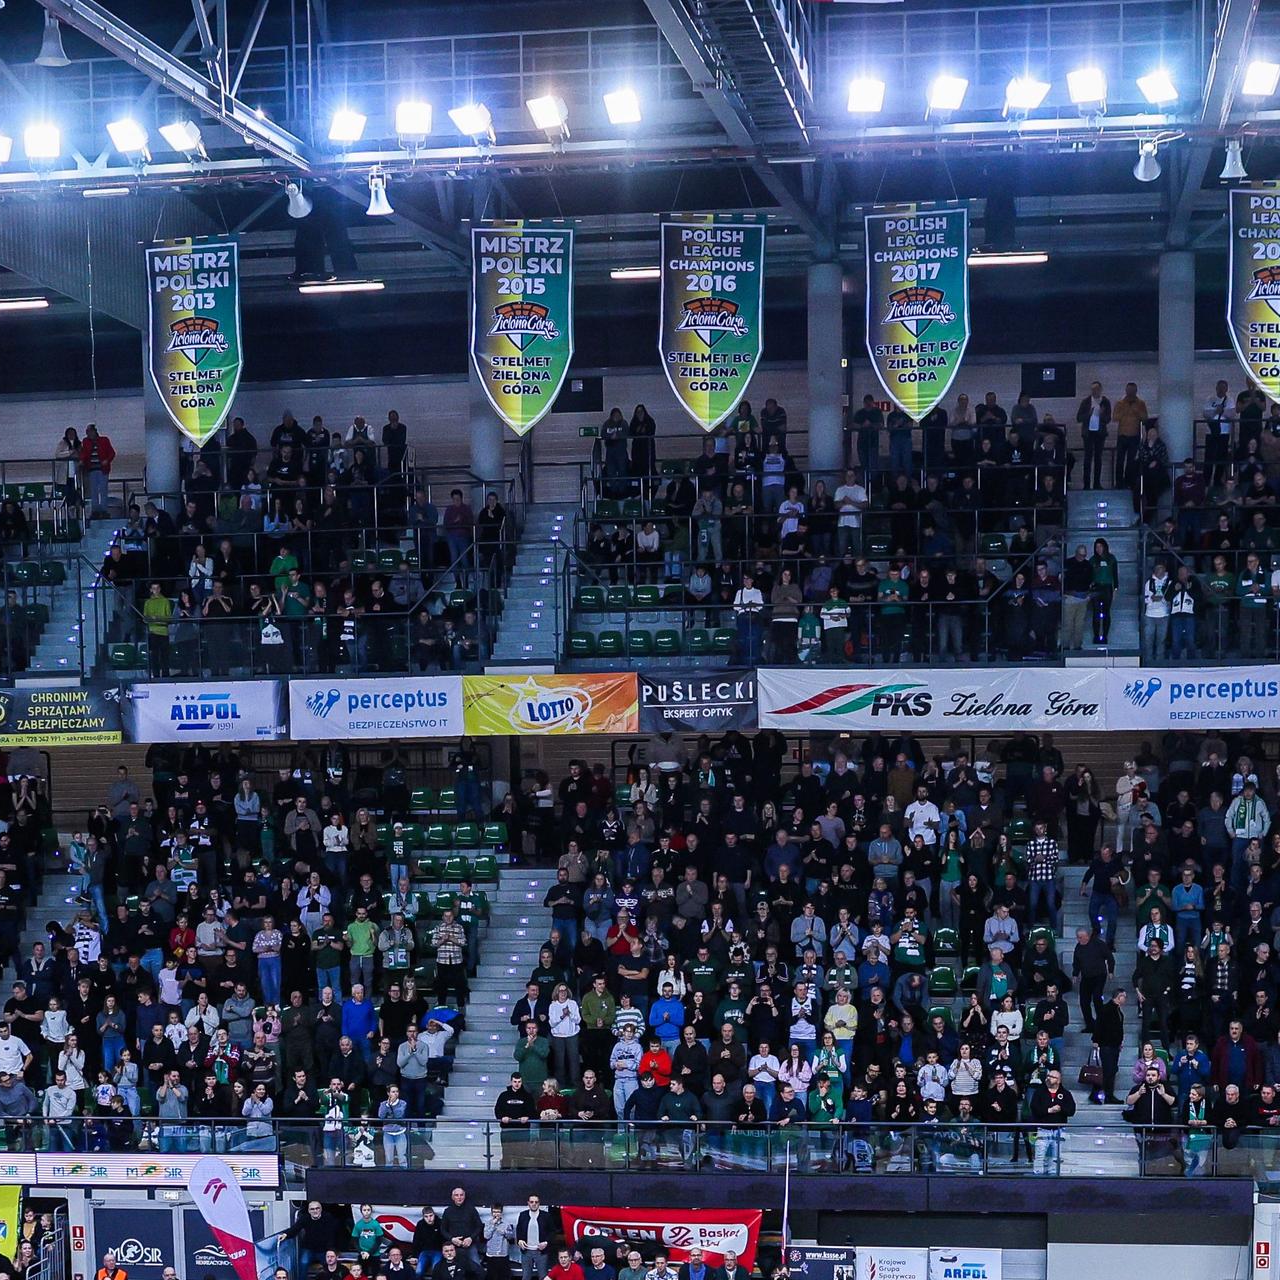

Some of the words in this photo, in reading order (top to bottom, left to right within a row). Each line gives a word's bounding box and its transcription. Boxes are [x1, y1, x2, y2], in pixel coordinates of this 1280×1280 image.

[885, 217, 948, 233] POLISH
[681, 229, 745, 243] POLISH
[887, 233, 945, 248] LEAGUE
[480, 236, 565, 255] MISTRZ
[683, 245, 742, 258] LEAGUE
[874, 246, 959, 263] CHAMPIONS
[154, 250, 230, 273] MISTRZ
[481, 257, 563, 274] POLSKI
[669, 259, 756, 272] CHAMPIONS
[891, 262, 941, 283] 2017
[155, 272, 230, 292] POLSKI
[497, 278, 546, 295] 2015
[685, 274, 737, 292] 2016
[171, 292, 216, 312] 2013
[875, 343, 936, 356] STELMET
[939, 341, 960, 352] BC
[490, 356, 551, 368] STELMET
[668, 352, 730, 364] STELMET
[732, 352, 752, 363] BC
[886, 357, 948, 370] ZIELONA
[169, 369, 223, 382] STELMET
[492, 369, 551, 382] ZIELONA
[678, 366, 740, 378] ZIELONA
[897, 370, 938, 384] GÓRA
[170, 383, 224, 396] ZIELONA
[502, 382, 542, 396] GÓRA
[689, 379, 730, 392] GÓRA
[180, 397, 216, 409] GÓRA
[31, 691, 89, 704] CHRONIMY
[1170, 679, 1279, 704] perceptus
[347, 689, 448, 714] perceptus
[871, 692, 933, 717] PKS
[943, 692, 1034, 717] Zielona
[1044, 691, 1100, 717] Góra
[27, 705, 92, 719] SPRZĄTAMY
[171, 703, 241, 721] ARPOL
[526, 696, 575, 722] LOTTO
[663, 708, 700, 719] EKSPERT
[702, 707, 734, 718] OPTYK
[1169, 710, 1266, 721] BEZPIECZEŃSTWO
[1268, 710, 1278, 718] IT
[17, 718, 106, 731] ZABEZPIECZAMY
[217, 722, 235, 731] 1991
[348, 719, 437, 730] BEZPIECZEŃSTWO
[439, 719, 449, 727] IT
[878, 1258, 907, 1267] Krajowa
[878, 1265, 900, 1274] Grupa
[878, 1272, 916, 1280] Spożywcza
[943, 1268, 988, 1280] ARPOL
